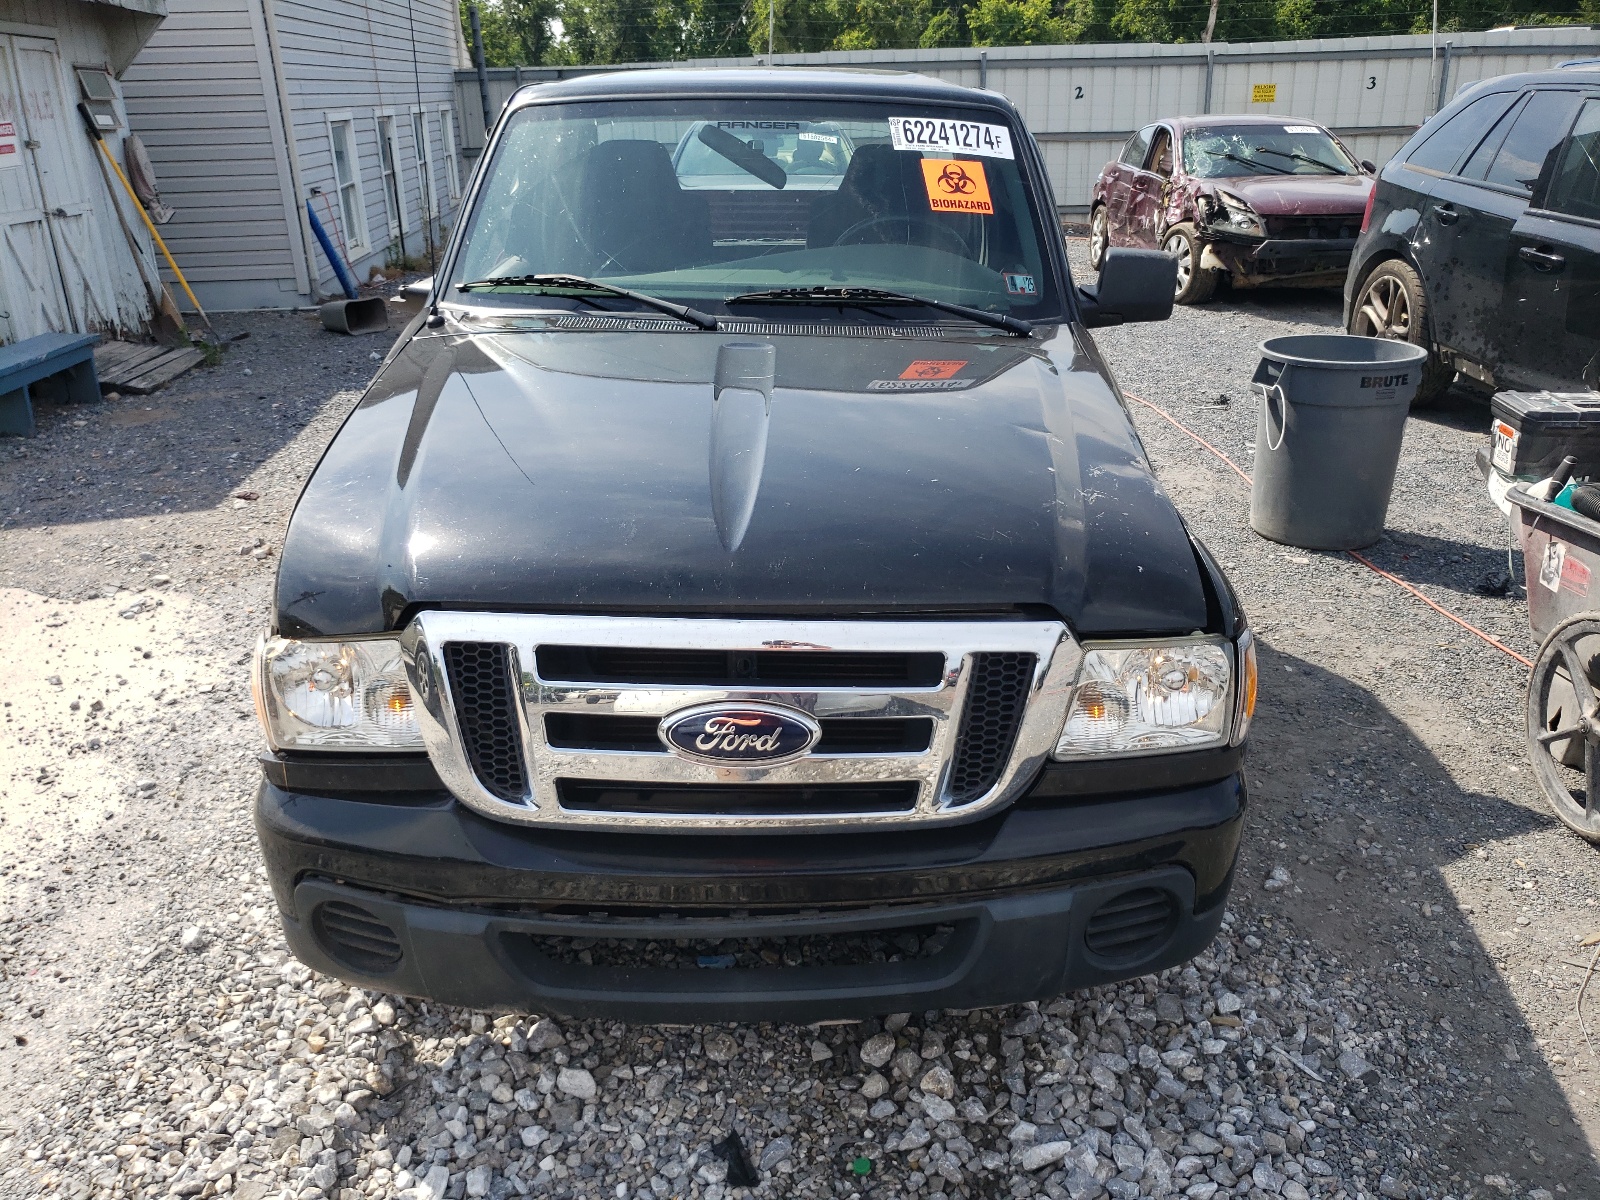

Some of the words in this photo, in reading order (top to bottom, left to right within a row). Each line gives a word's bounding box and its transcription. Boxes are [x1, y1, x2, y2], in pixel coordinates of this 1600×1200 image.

[1366, 76, 1377, 90] 3
[1074, 86, 1084, 100] 2
[717, 121, 800, 130] RANGER
[931, 198, 991, 211] BIOHAZARD
[1360, 373, 1409, 389] BRUTE
[695, 716, 782, 751] Ford
